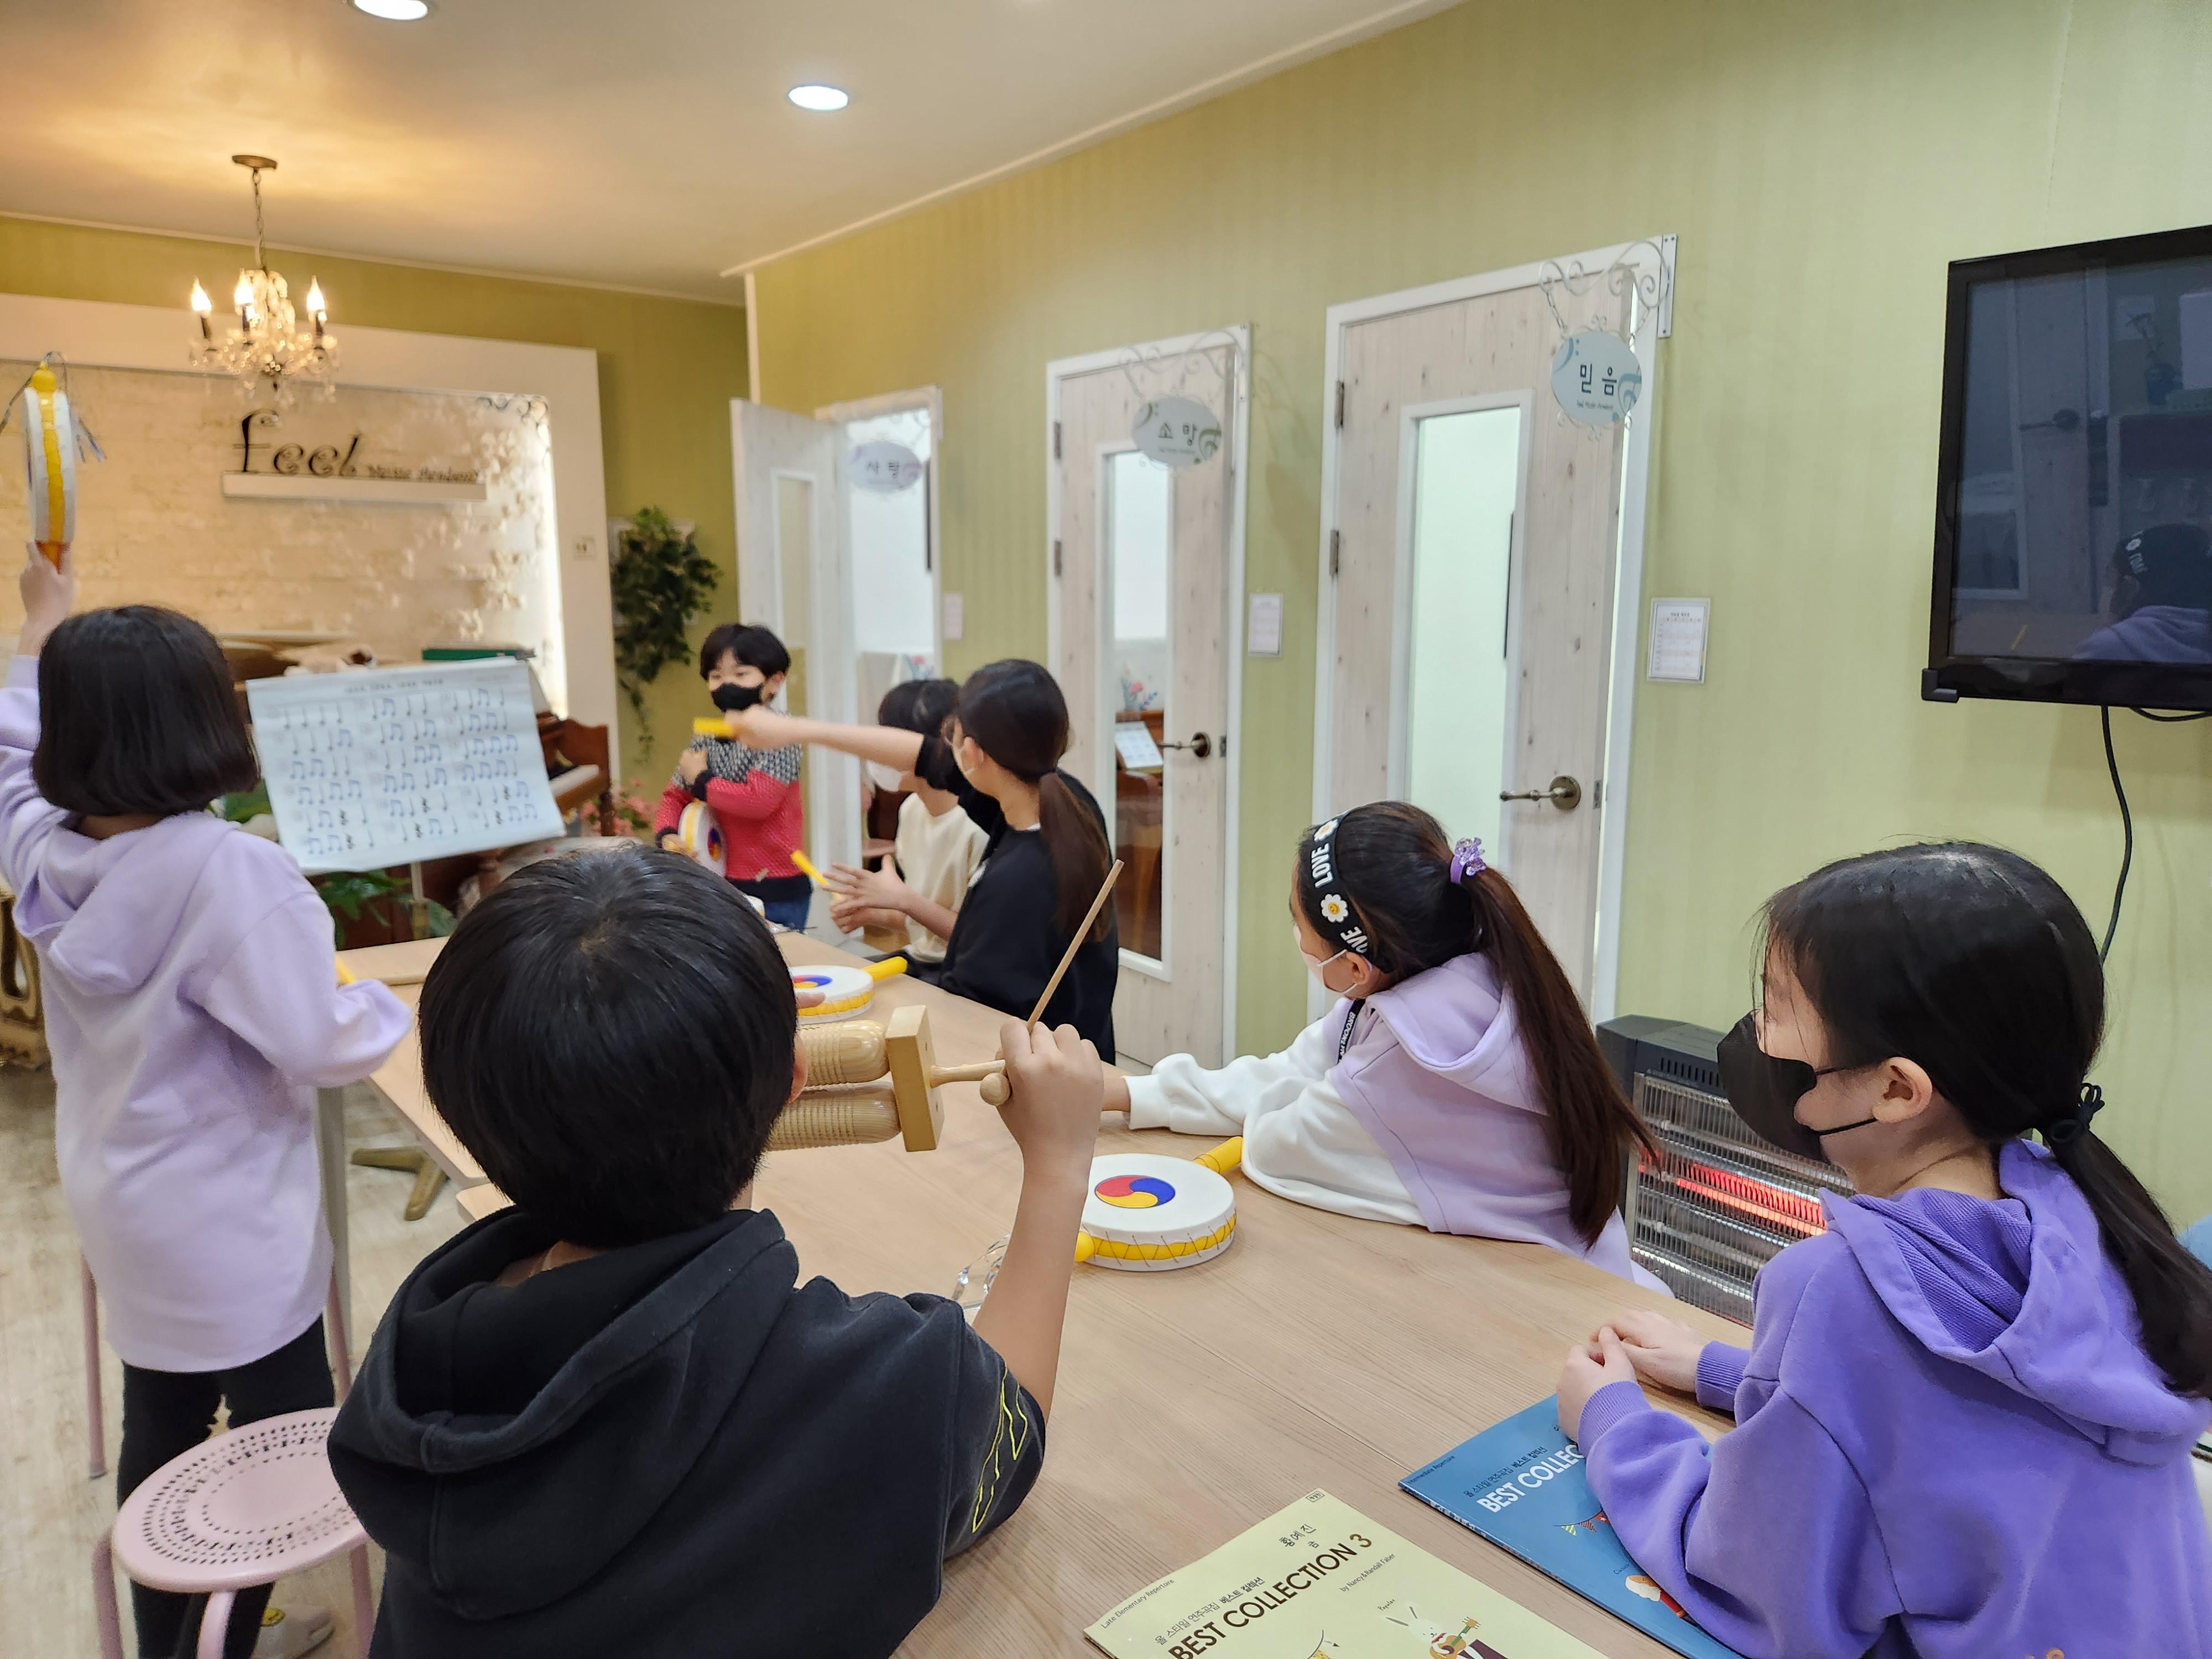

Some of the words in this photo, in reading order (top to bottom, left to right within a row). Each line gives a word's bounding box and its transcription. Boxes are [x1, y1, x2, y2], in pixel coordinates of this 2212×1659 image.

[1311, 843, 1333, 888] LOVE
[1512, 1456, 1531, 1468] 베스트
[1477, 1482, 1526, 1512] BEST
[1380, 1553, 1395, 1564] Faber
[1101, 1616, 1116, 1629] Late
[1114, 1595, 1147, 1618] Elementary
[1145, 1579, 1174, 1597] Repertoire
[1155, 1635, 1168, 1645] 올
[1167, 1619, 1191, 1638] 스타일
[1187, 1602, 1220, 1623] 연주곡집
[1219, 1589, 1244, 1604] 베스트
[1240, 1577, 1265, 1593] 컬렉션
[1167, 1621, 1227, 1659] BEST
[1223, 1542, 1358, 1627] COLLECTION
[1349, 1533, 1372, 1548] 3
